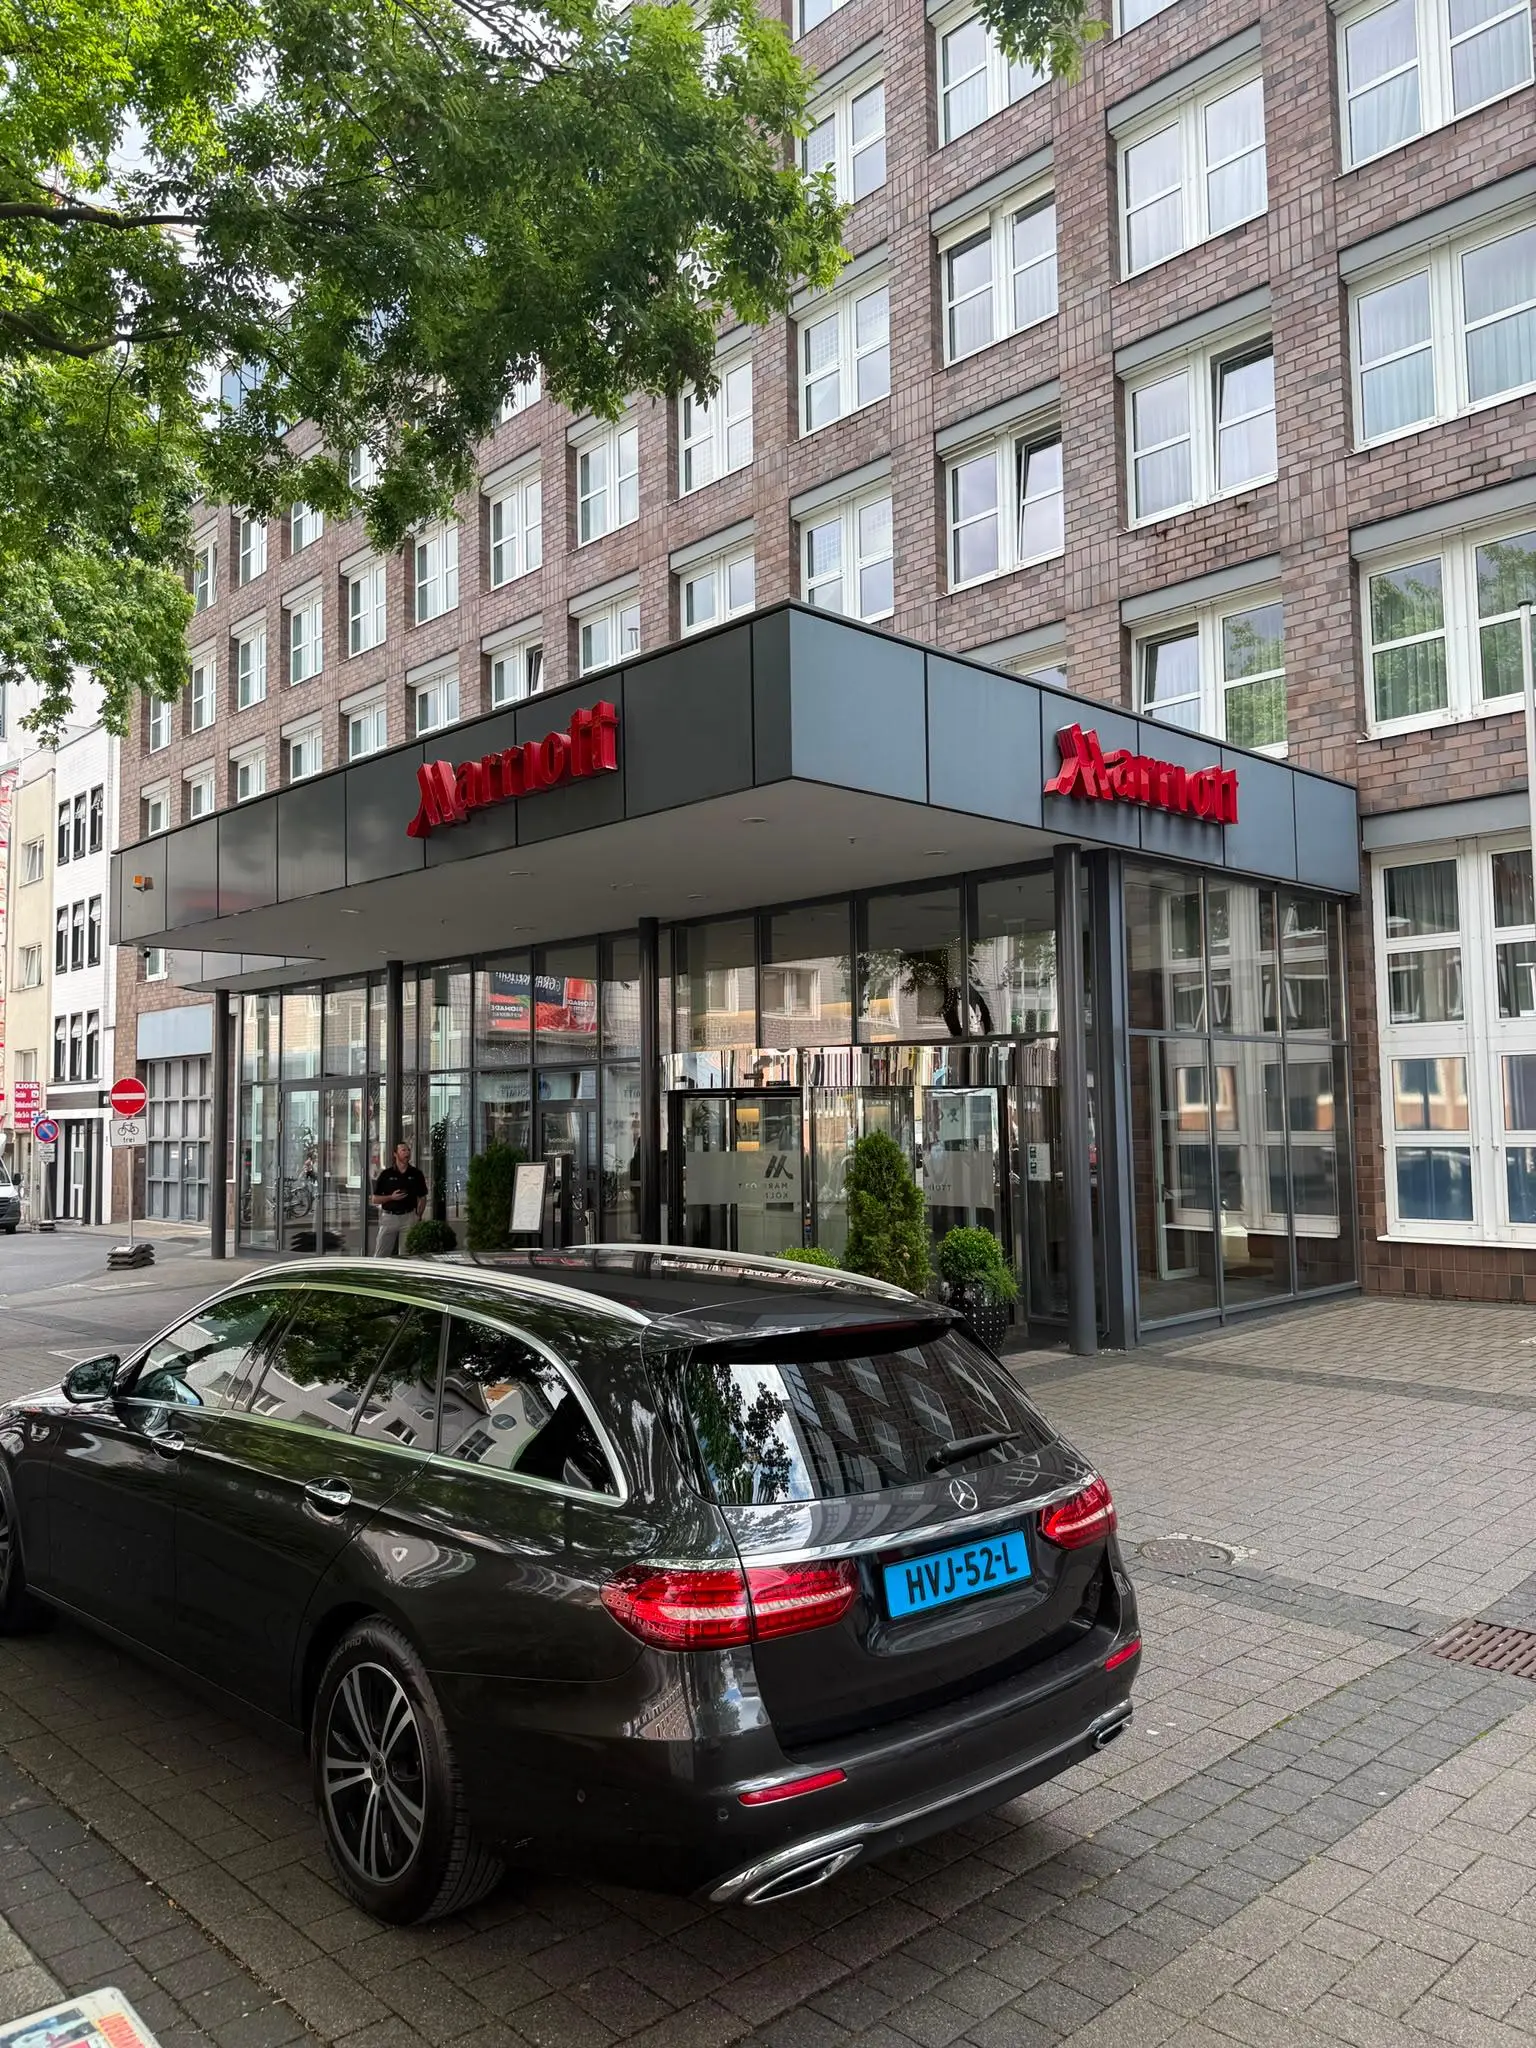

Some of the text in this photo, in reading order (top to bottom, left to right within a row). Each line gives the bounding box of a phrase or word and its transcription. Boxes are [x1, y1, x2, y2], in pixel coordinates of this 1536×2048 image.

[406, 700, 619, 838] Marriott
[1043, 721, 1240, 825] Marriott
[905, 1541, 1018, 1605] HVJ-52-L
